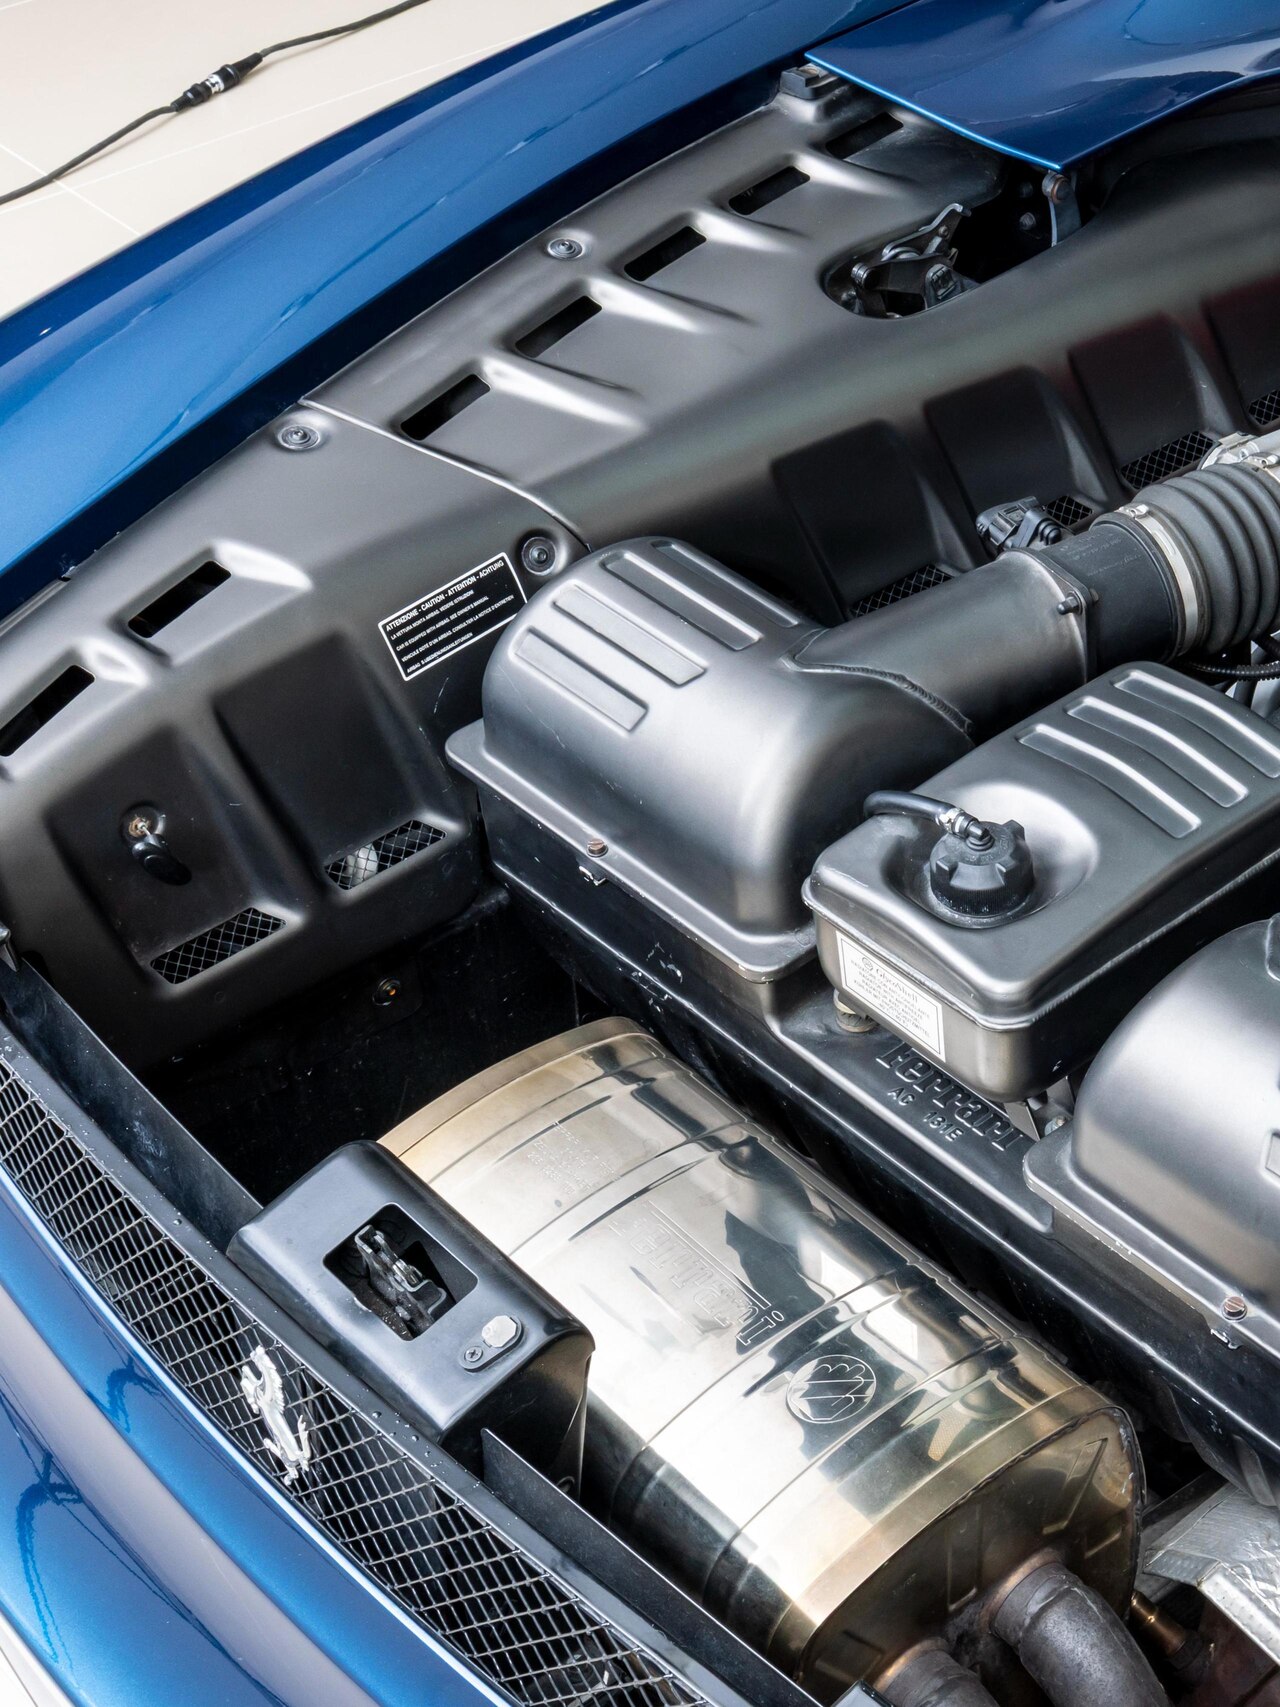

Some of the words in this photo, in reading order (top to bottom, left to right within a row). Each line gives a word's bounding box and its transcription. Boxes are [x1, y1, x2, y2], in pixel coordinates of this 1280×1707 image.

[385, 608, 419, 632] ATTENZIONE
[421, 593, 445, 611] CAUTION
[447, 575, 477, 596] ATTENTION
[478, 559, 505, 578] ACHTUNG
[395, 624, 413, 637] VETTURA
[395, 643, 405, 651] CAR
[408, 630, 427, 644] EQUIPPED
[426, 625, 436, 634] WITH
[887, 1087, 916, 1106] AC
